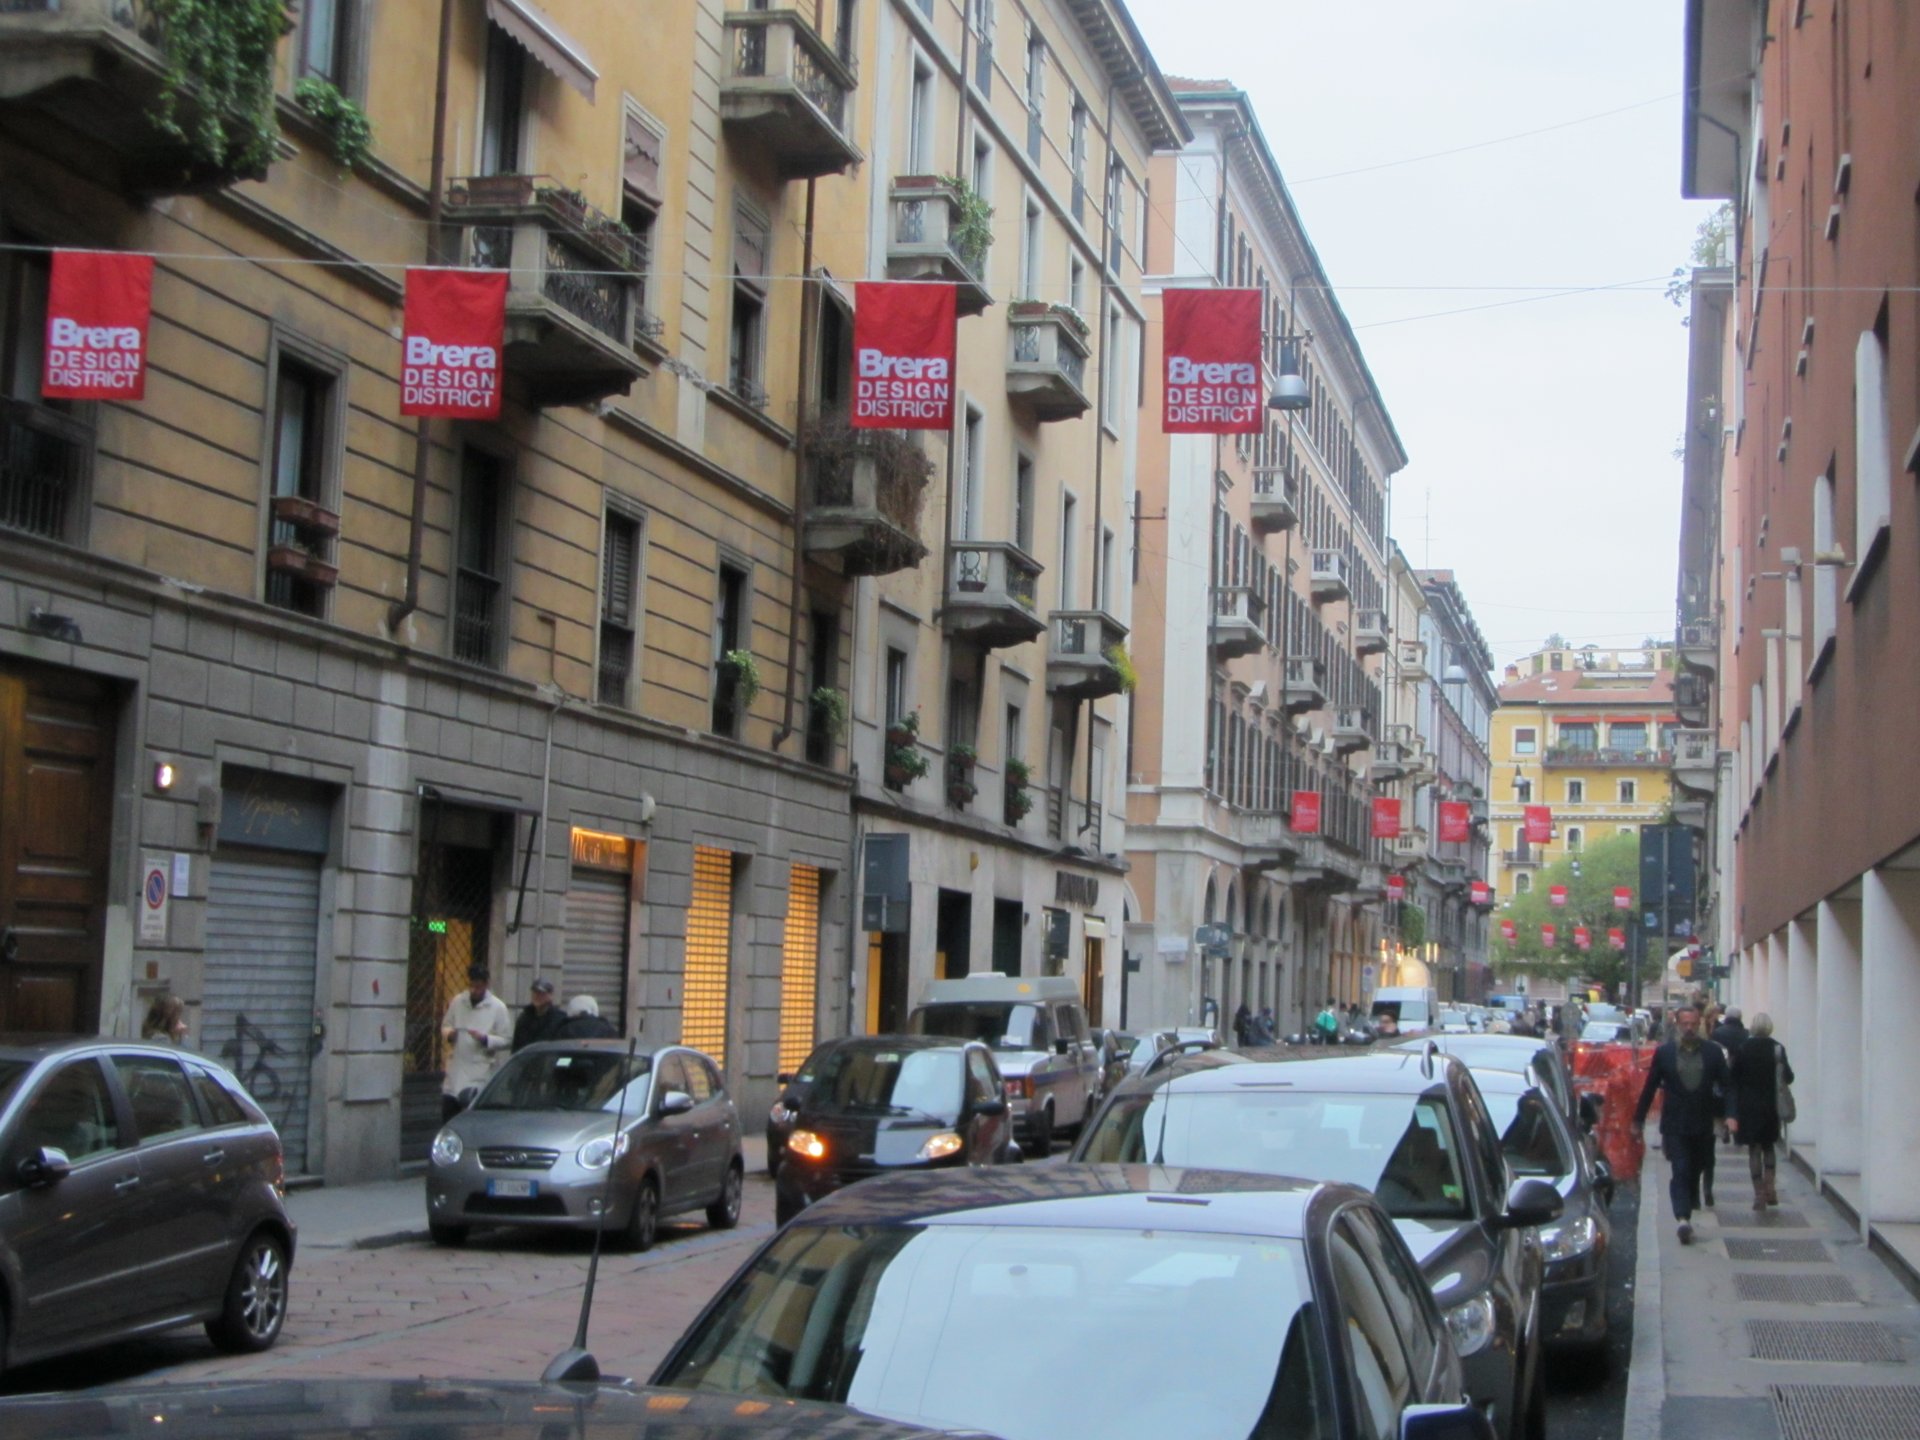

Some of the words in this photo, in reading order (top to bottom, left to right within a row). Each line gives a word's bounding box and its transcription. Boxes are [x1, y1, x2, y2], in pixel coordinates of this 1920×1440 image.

[51, 317, 141, 349] Brera
[49, 350, 140, 370] DESIGN
[406, 336, 497, 369] Brera
[859, 348, 948, 379] Brera
[1168, 356, 1256, 385] Brera
[48, 368, 139, 388] DISTRICT
[404, 368, 496, 389] DESIGN
[403, 386, 494, 408] DISTRICT
[858, 380, 949, 400] DESIGN
[1167, 387, 1257, 405] DESIGN
[857, 399, 947, 418] DISTRICT
[1167, 405, 1256, 423] DISTRICT
